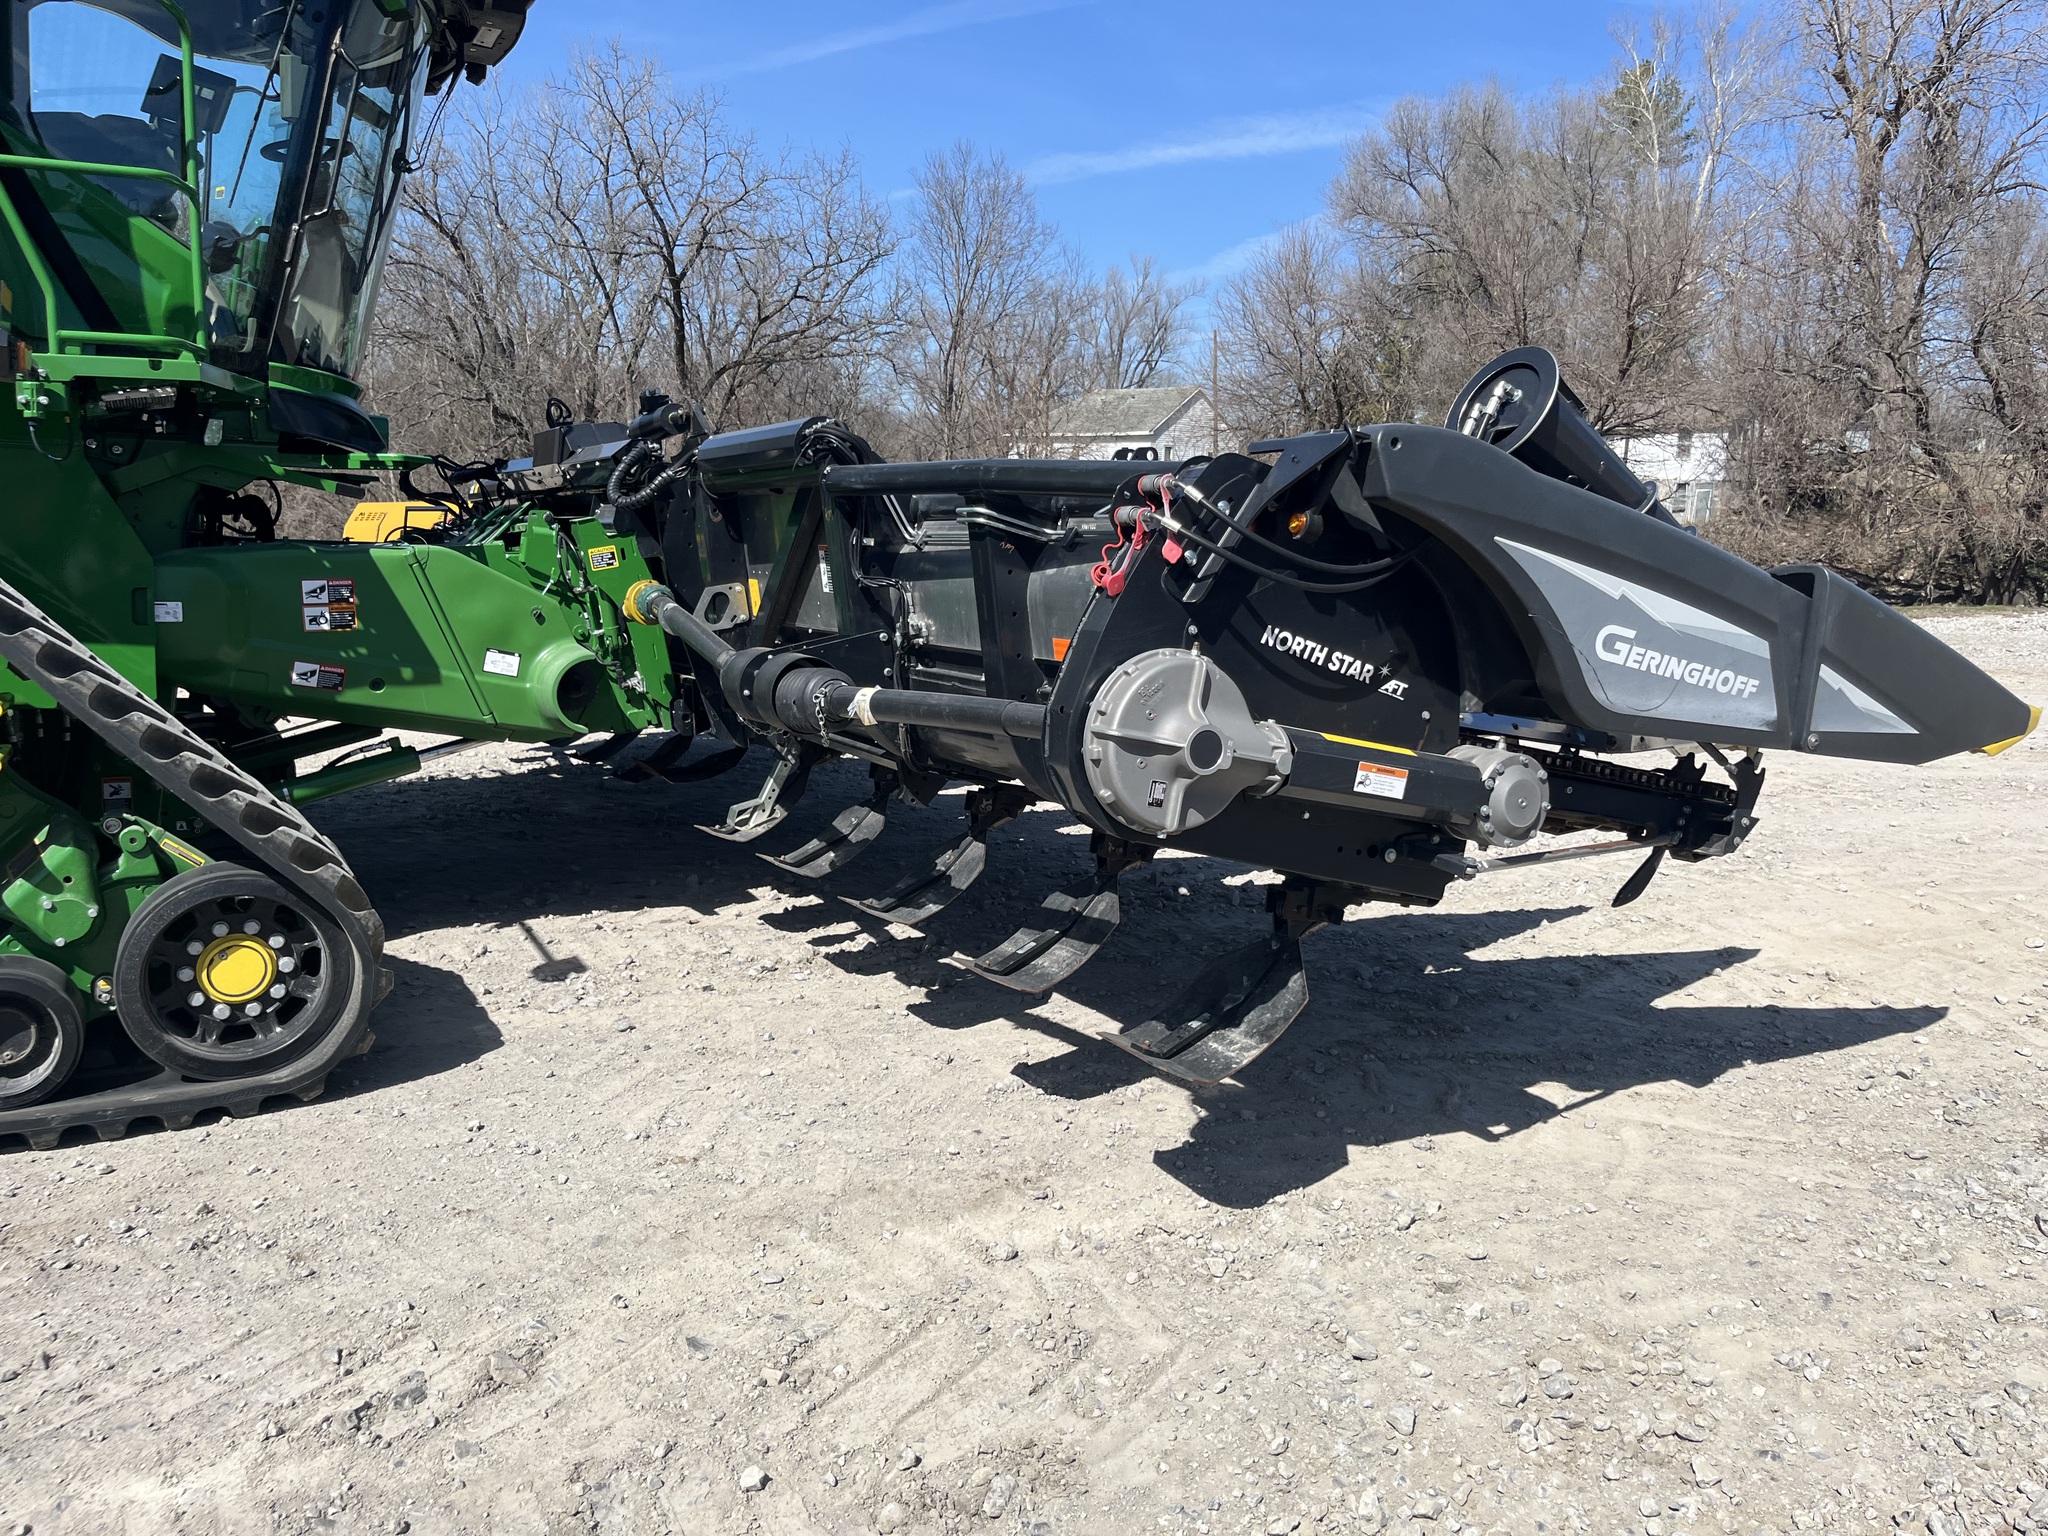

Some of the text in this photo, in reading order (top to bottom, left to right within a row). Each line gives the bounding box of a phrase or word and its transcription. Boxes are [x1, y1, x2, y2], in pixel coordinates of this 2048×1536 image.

[1260, 625, 1375, 684] NORTH STAR
[1595, 624, 1760, 699] GERINGHOFF
[1381, 679, 1409, 696] AFT
